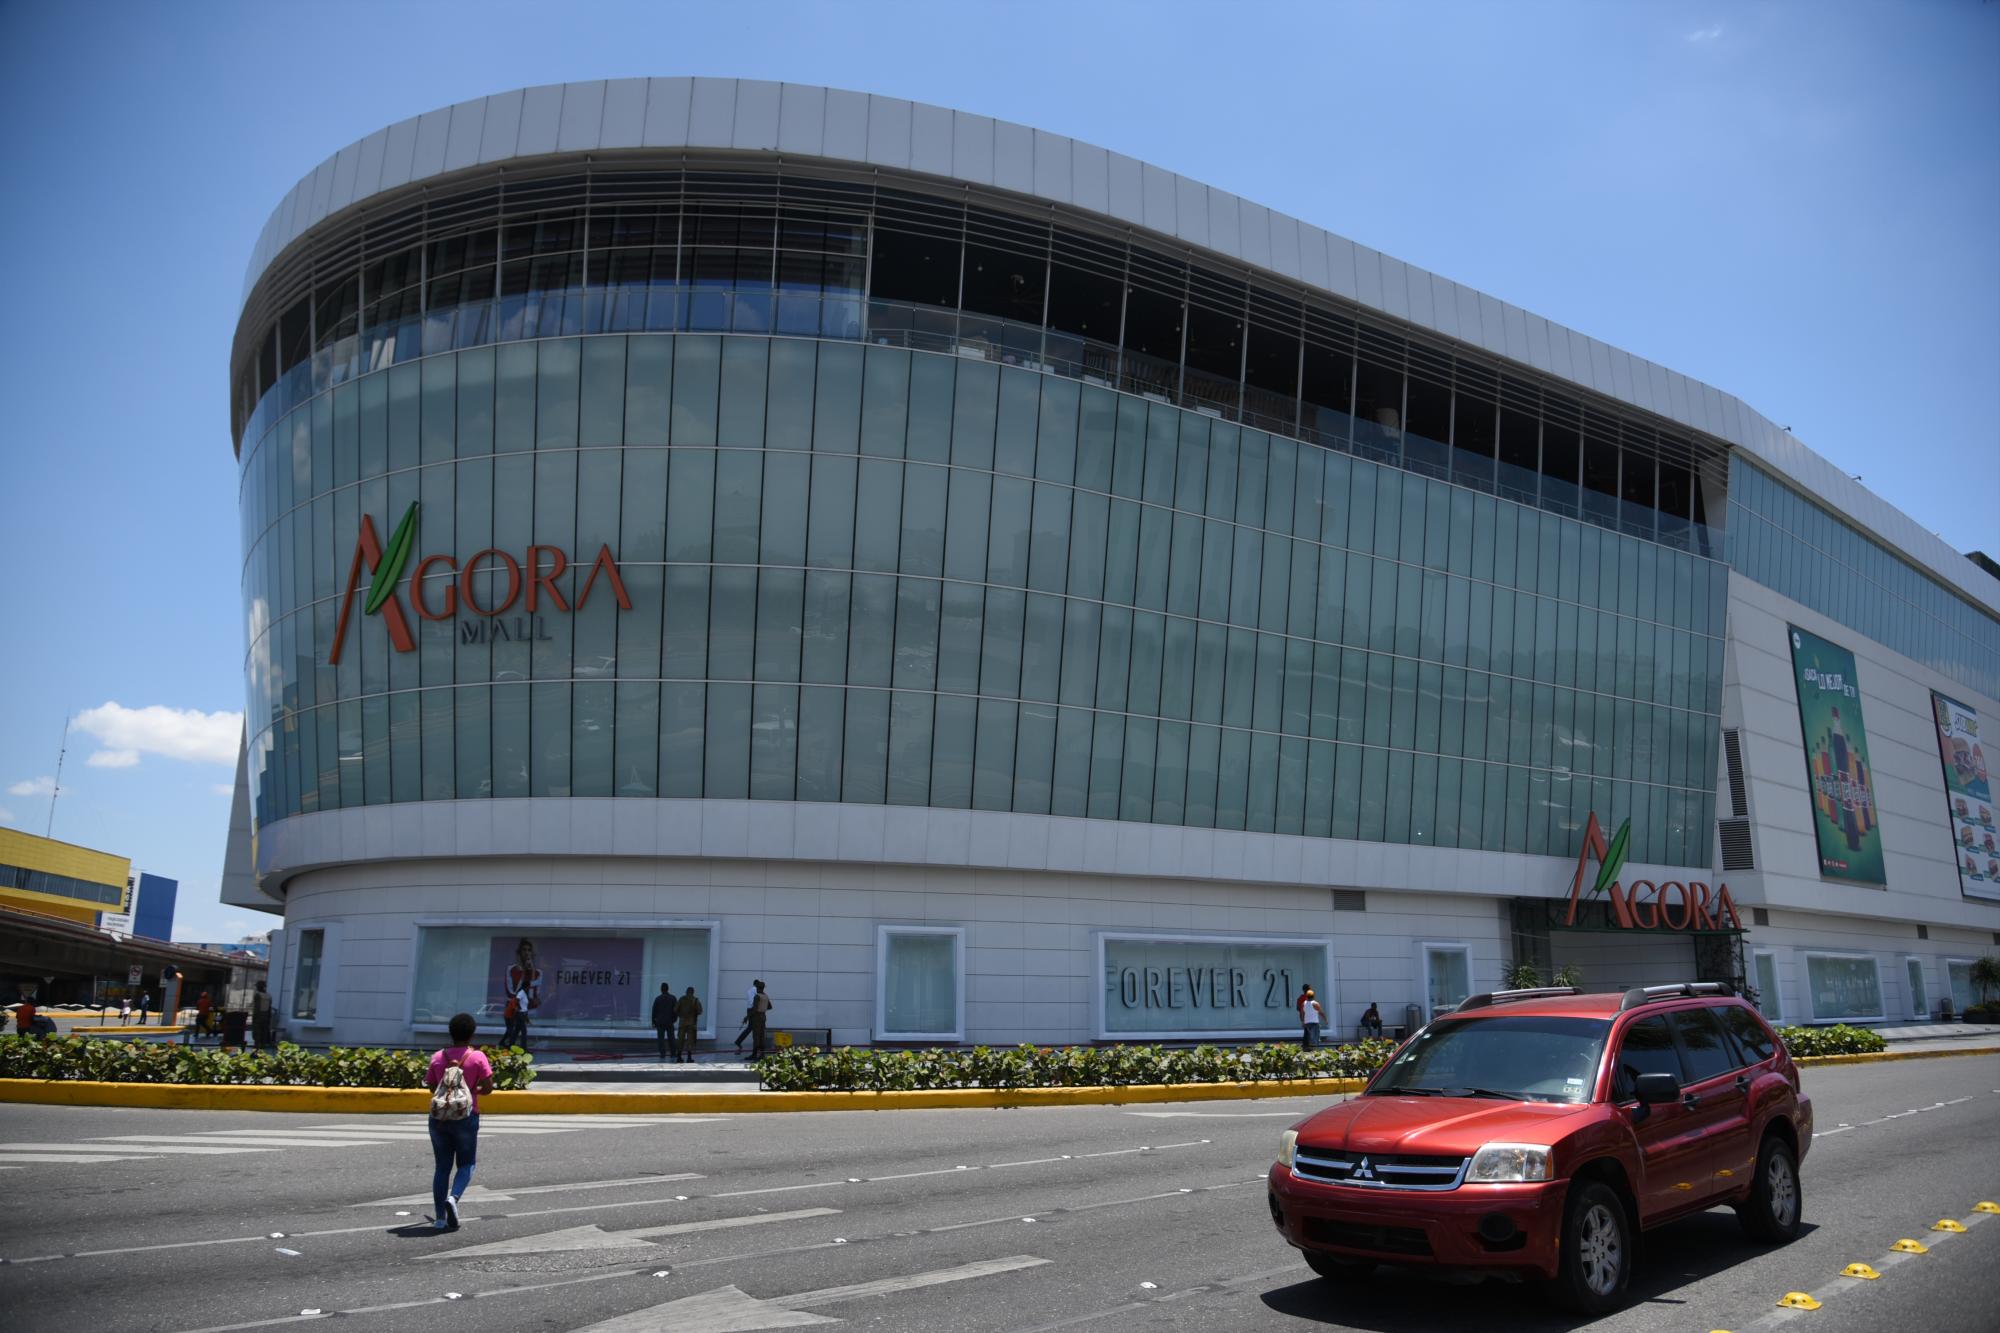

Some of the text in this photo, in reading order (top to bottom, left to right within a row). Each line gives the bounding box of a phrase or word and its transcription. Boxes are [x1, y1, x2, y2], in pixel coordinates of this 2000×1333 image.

[460, 616, 553, 645] MALL
[556, 970, 631, 985] FOREVER 21
[1263, 967, 1294, 1009] 21
